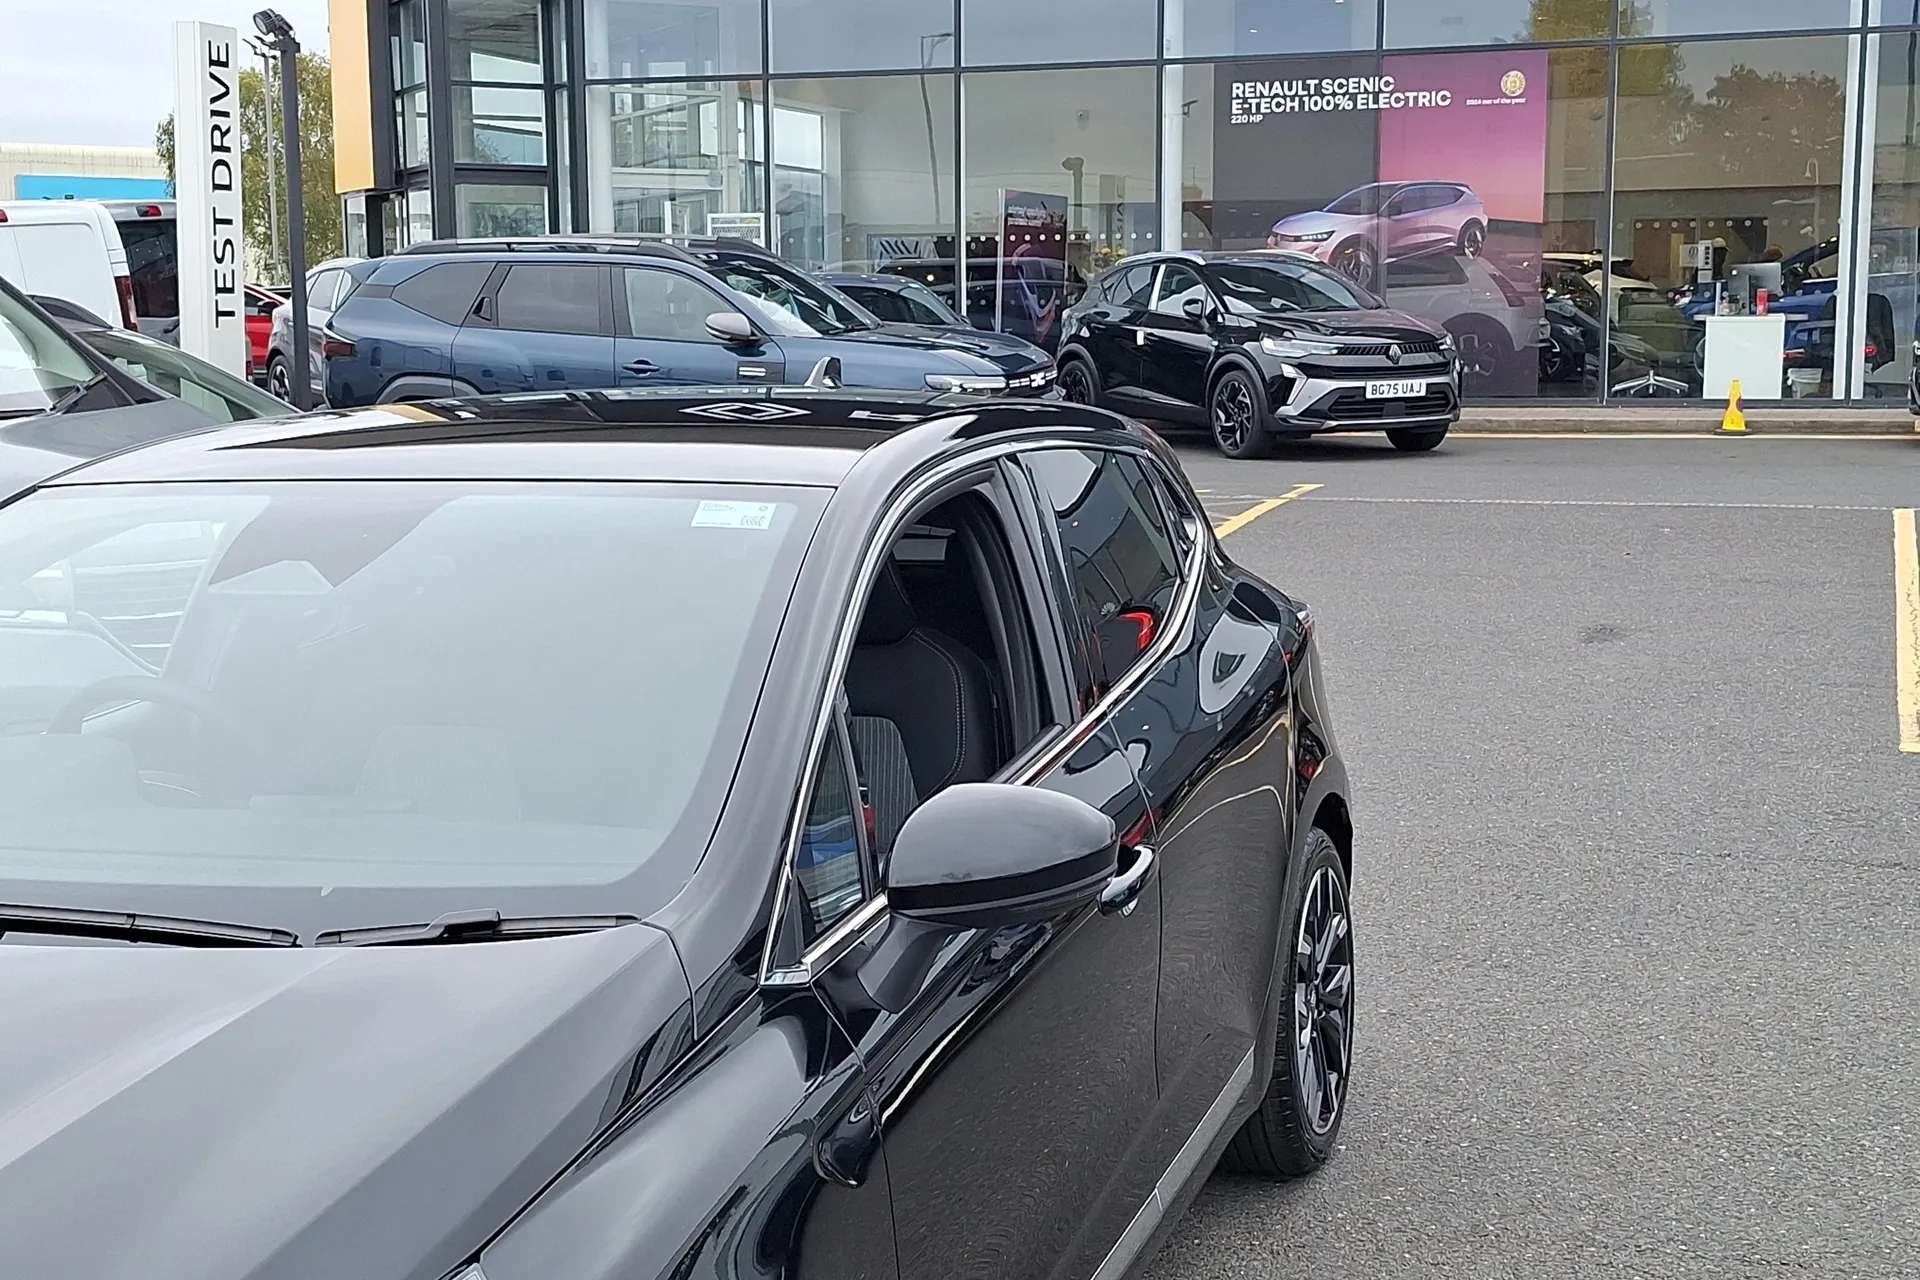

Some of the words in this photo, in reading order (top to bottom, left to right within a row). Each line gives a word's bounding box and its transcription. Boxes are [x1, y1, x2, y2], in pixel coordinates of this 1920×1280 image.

[1231, 79, 1319, 98] RENAULT
[1321, 75, 1395, 95] SCENIC
[1231, 96, 1299, 115] E-TECH
[1302, 94, 1354, 112] 100%
[1356, 90, 1452, 110] ELECTRIC
[208, 39, 233, 193] DRIVE
[1230, 114, 1249, 124] 220
[1249, 114, 1264, 123] HP
[212, 206, 236, 329] TEST
[1371, 383, 1399, 396] BG75
[1401, 382, 1422, 394] UAJ
